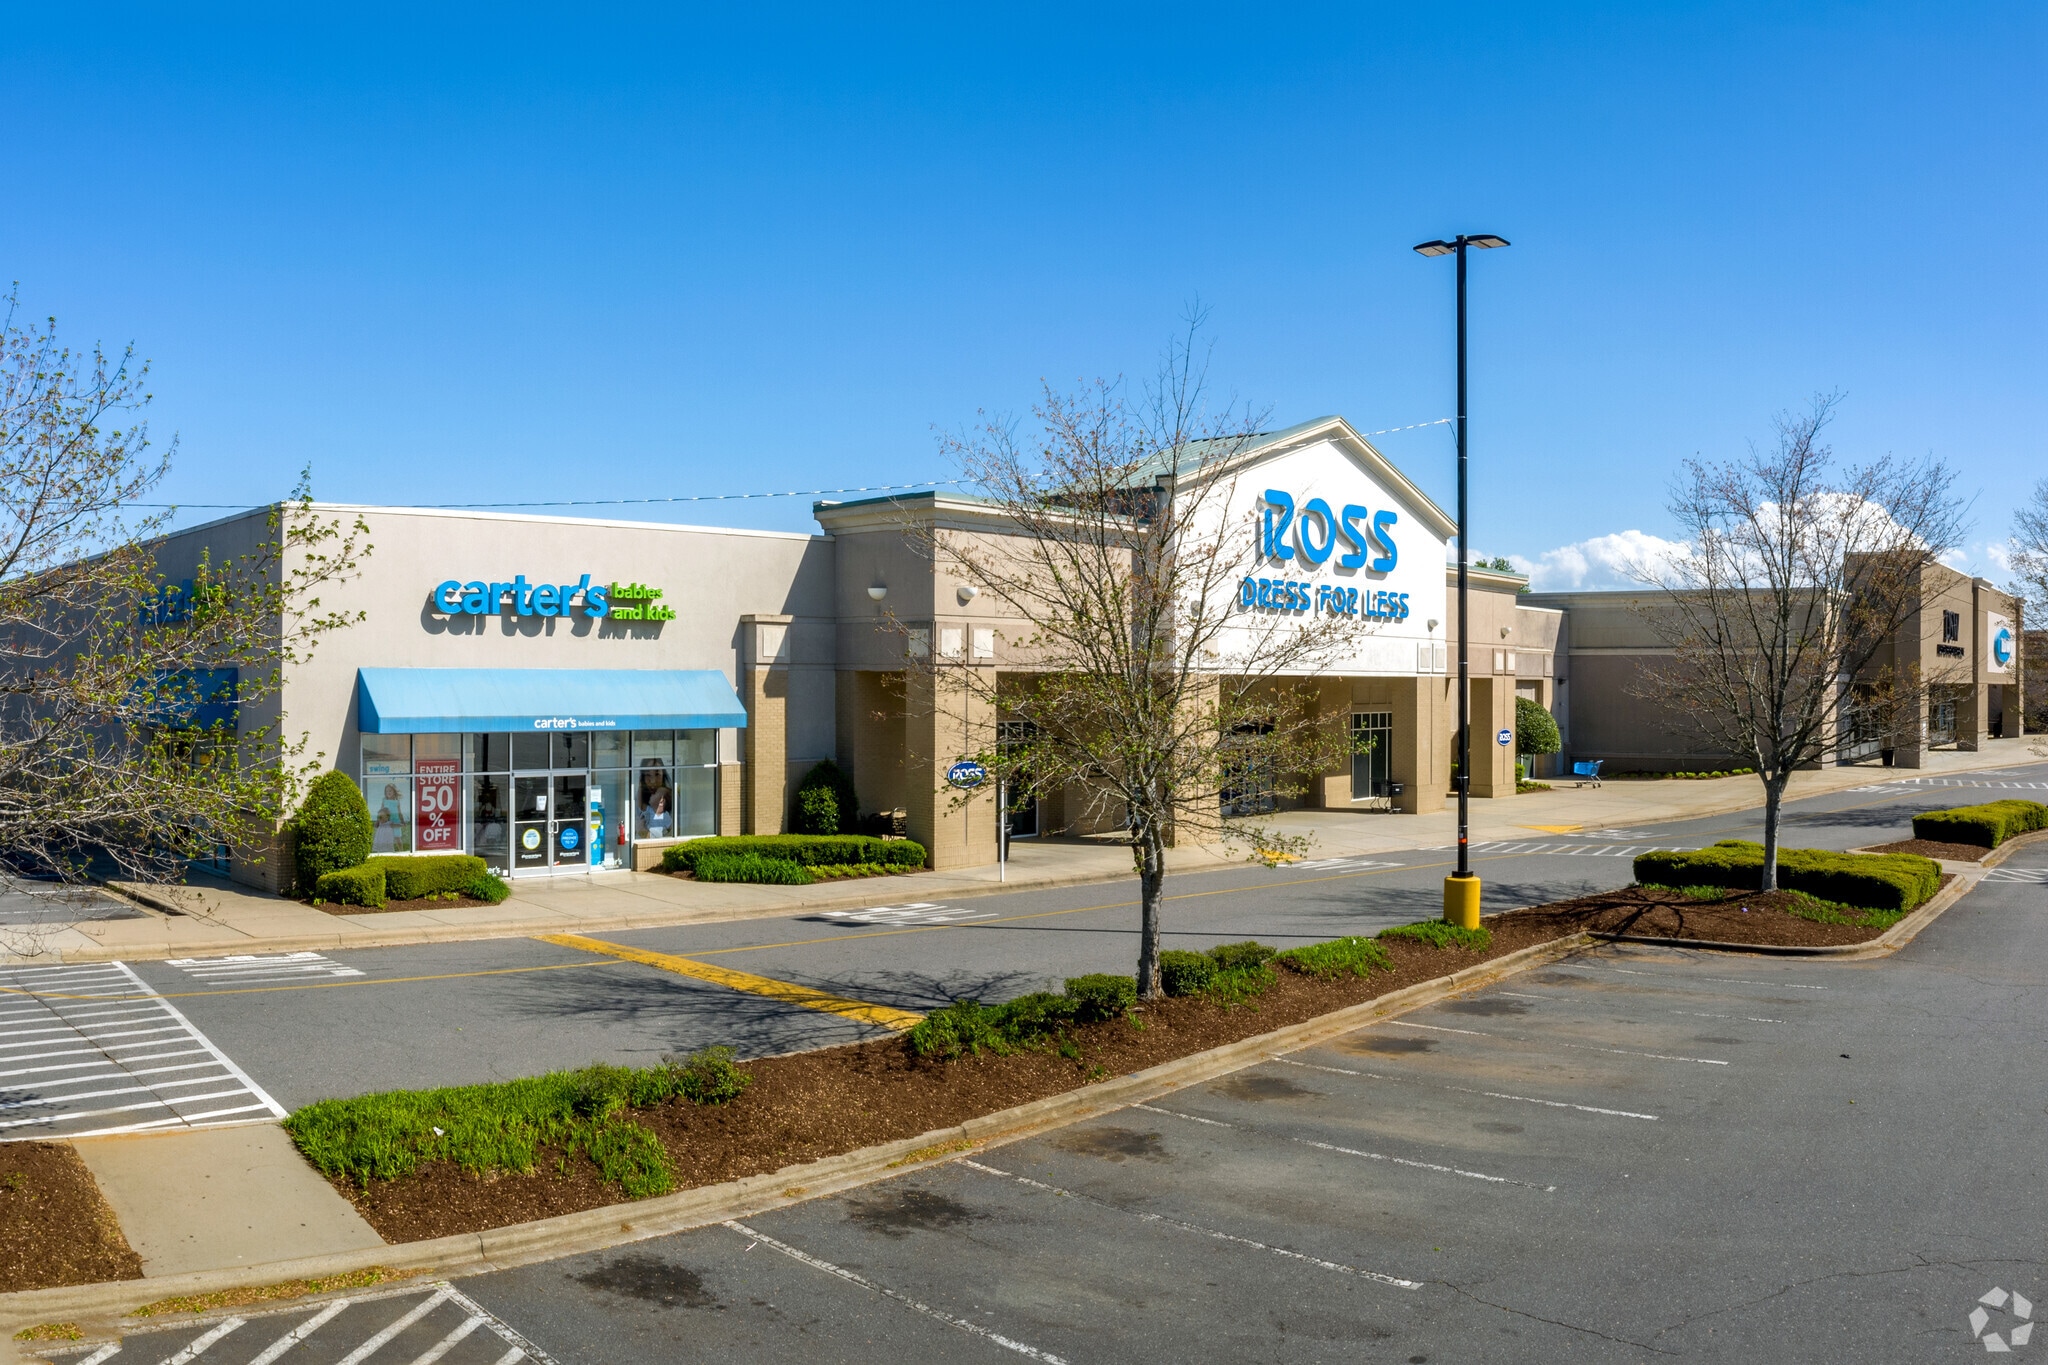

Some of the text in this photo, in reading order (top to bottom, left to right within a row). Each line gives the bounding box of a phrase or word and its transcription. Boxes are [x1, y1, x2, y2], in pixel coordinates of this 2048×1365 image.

[1264, 489, 1398, 572] ROSS
[434, 574, 664, 617] carter's babies
[1242, 577, 1409, 618] DRESS FOR LESS
[612, 604, 677, 621] and kids
[534, 717, 577, 728] carter's
[605, 719, 616, 727] kids
[420, 765, 456, 774] ENTIRE
[952, 767, 983, 781] ROSS
[419, 775, 456, 785] STORE
[421, 785, 453, 812] 50
[429, 812, 445, 828] %
[422, 828, 452, 842] OFF
[164, 951, 367, 985] LANE
